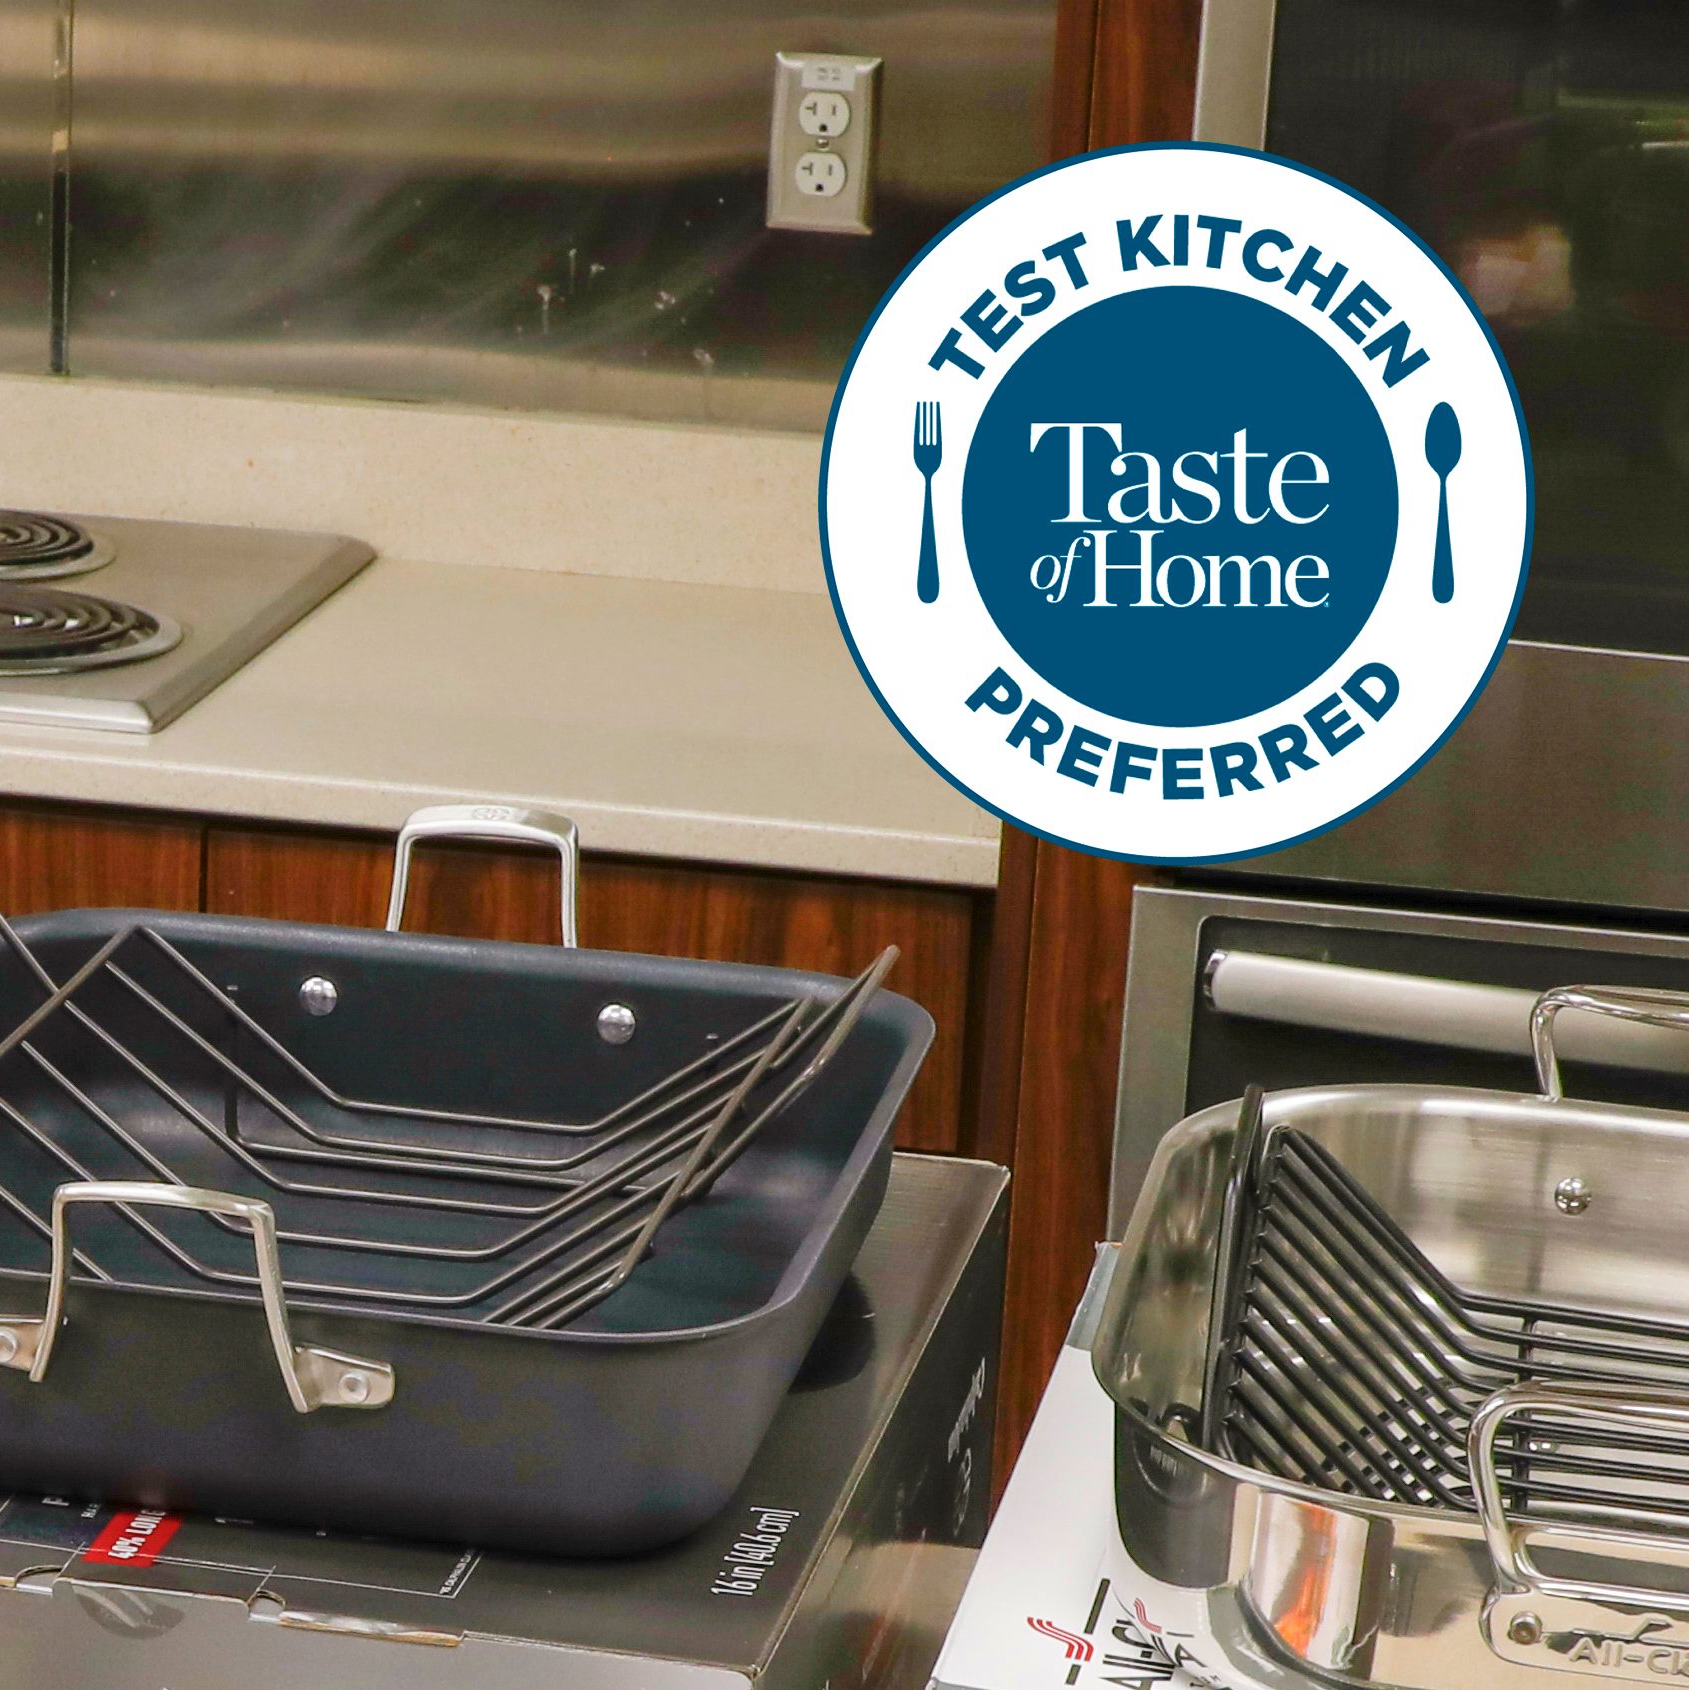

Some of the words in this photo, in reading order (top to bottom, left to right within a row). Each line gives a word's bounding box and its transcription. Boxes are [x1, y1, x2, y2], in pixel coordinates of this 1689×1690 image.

[750, 1506, 800, 1533] cm]
[723, 1533, 782, 1566] [40.6
[719, 1566, 766, 1580] in
[710, 1579, 758, 1596] 16
[1569, 1636, 1689, 1677] All-Cla
